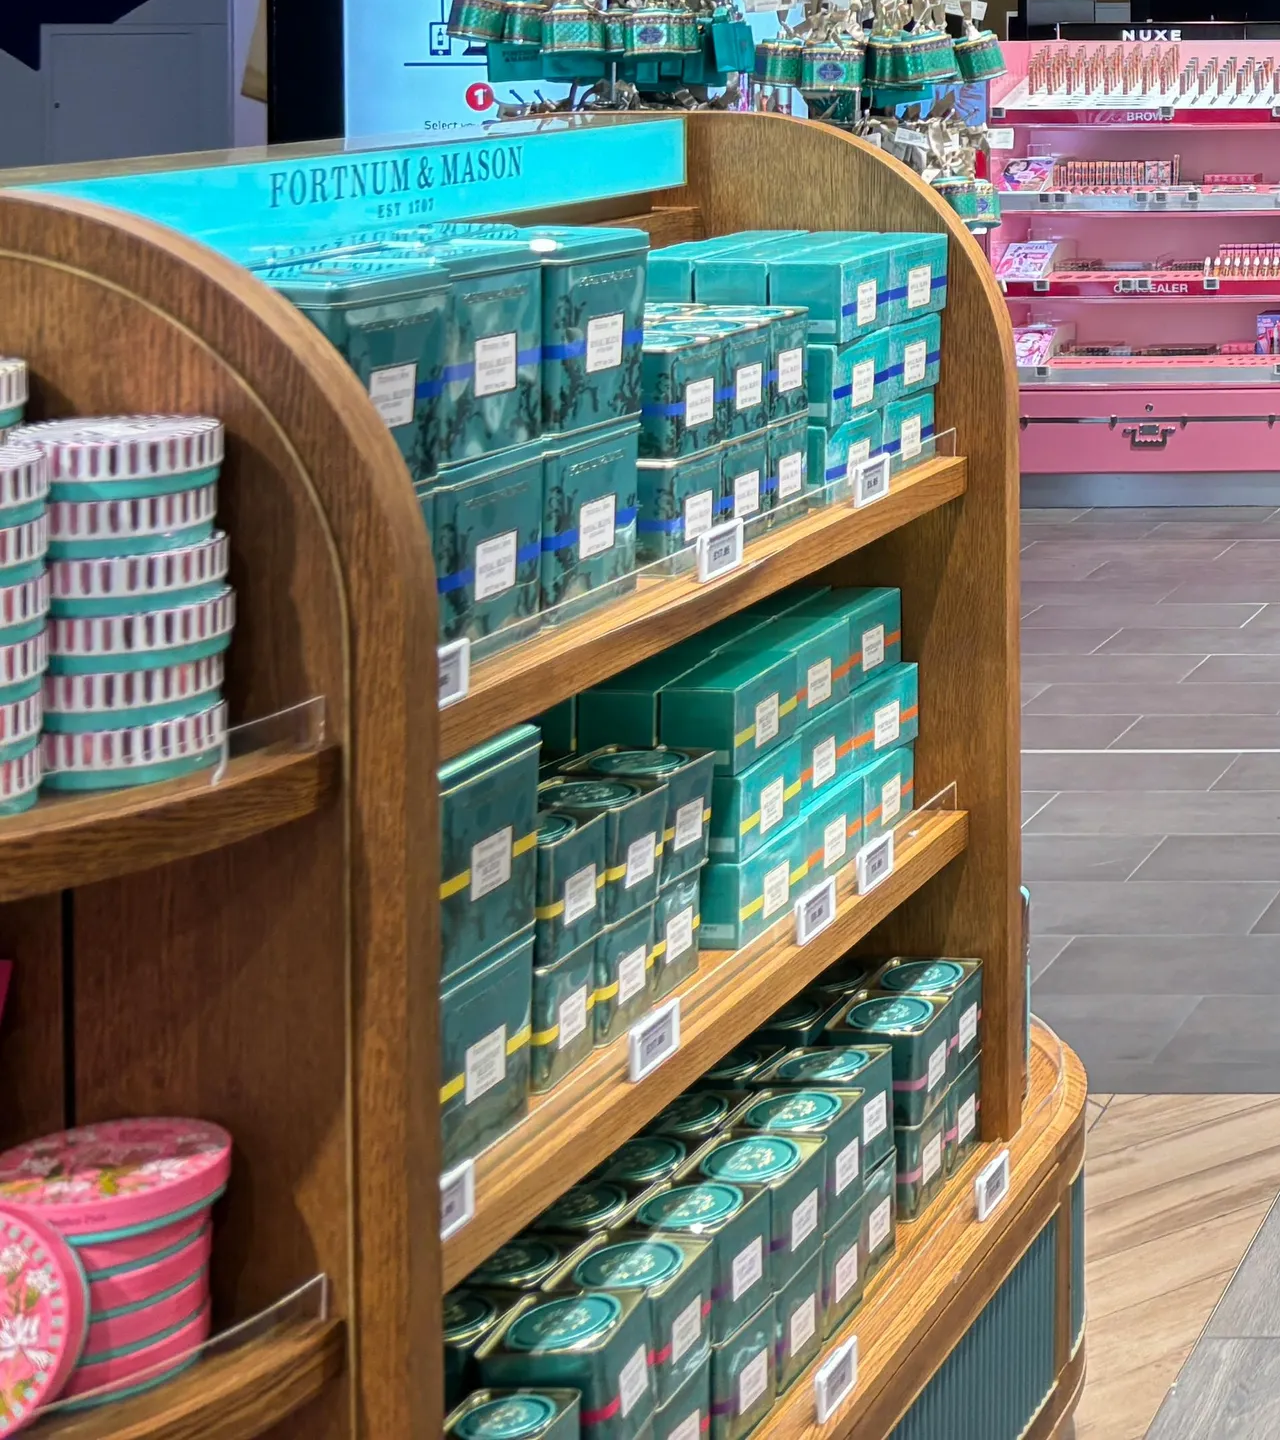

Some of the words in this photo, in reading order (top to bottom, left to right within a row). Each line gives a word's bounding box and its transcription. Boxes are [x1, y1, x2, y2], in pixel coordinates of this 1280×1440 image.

[1122, 29, 1182, 42] NUXE
[424, 120, 458, 131] Select
[269, 157, 410, 208] FORTNUM
[417, 155, 435, 190] &
[440, 145, 524, 187] MASON
[377, 201, 402, 219] EST
[408, 197, 434, 215] 1707
